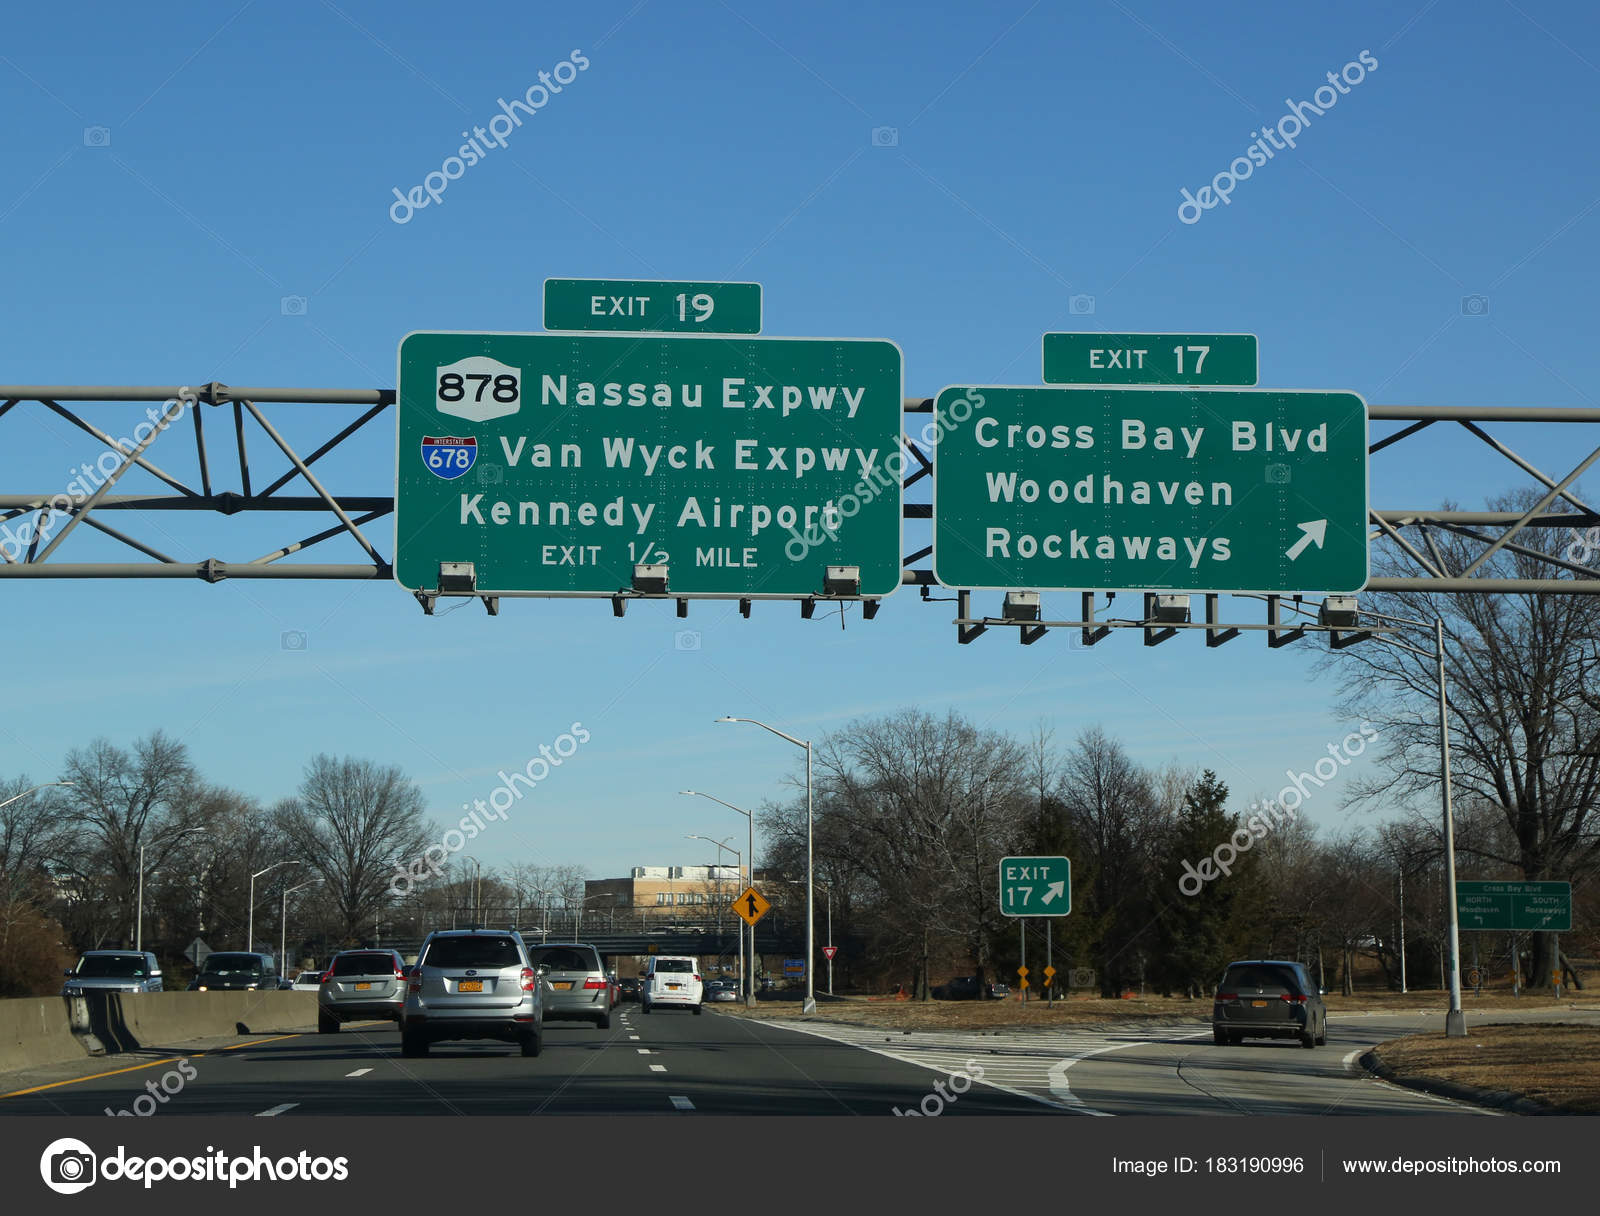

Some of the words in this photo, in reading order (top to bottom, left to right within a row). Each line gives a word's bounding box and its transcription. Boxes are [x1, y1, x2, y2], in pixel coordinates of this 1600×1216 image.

[591, 296, 650, 316] EXIT
[676, 293, 715, 322] 19
[1090, 349, 1148, 369] EXIT
[1173, 346, 1210, 374] 17
[438, 373, 519, 403] 878
[542, 375, 702, 407] Nassau
[722, 378, 865, 418] Expwy
[975, 417, 1095, 449] Cross
[1121, 419, 1205, 459] Bay
[1232, 421, 1327, 452] Blvd
[429, 448, 470, 469] 678
[500, 436, 582, 468] Van
[603, 438, 715, 476] Wyck
[736, 439, 879, 480] Expwy
[986, 472, 1232, 506] Woodhaven
[460, 495, 655, 534] Kennedy
[677, 497, 840, 536] Airport
[542, 546, 601, 565] EXIT
[696, 547, 757, 567] MILE
[986, 528, 1232, 569] Rockaways
[1007, 867, 1050, 880] EXIT
[1007, 887, 1033, 906] 17
